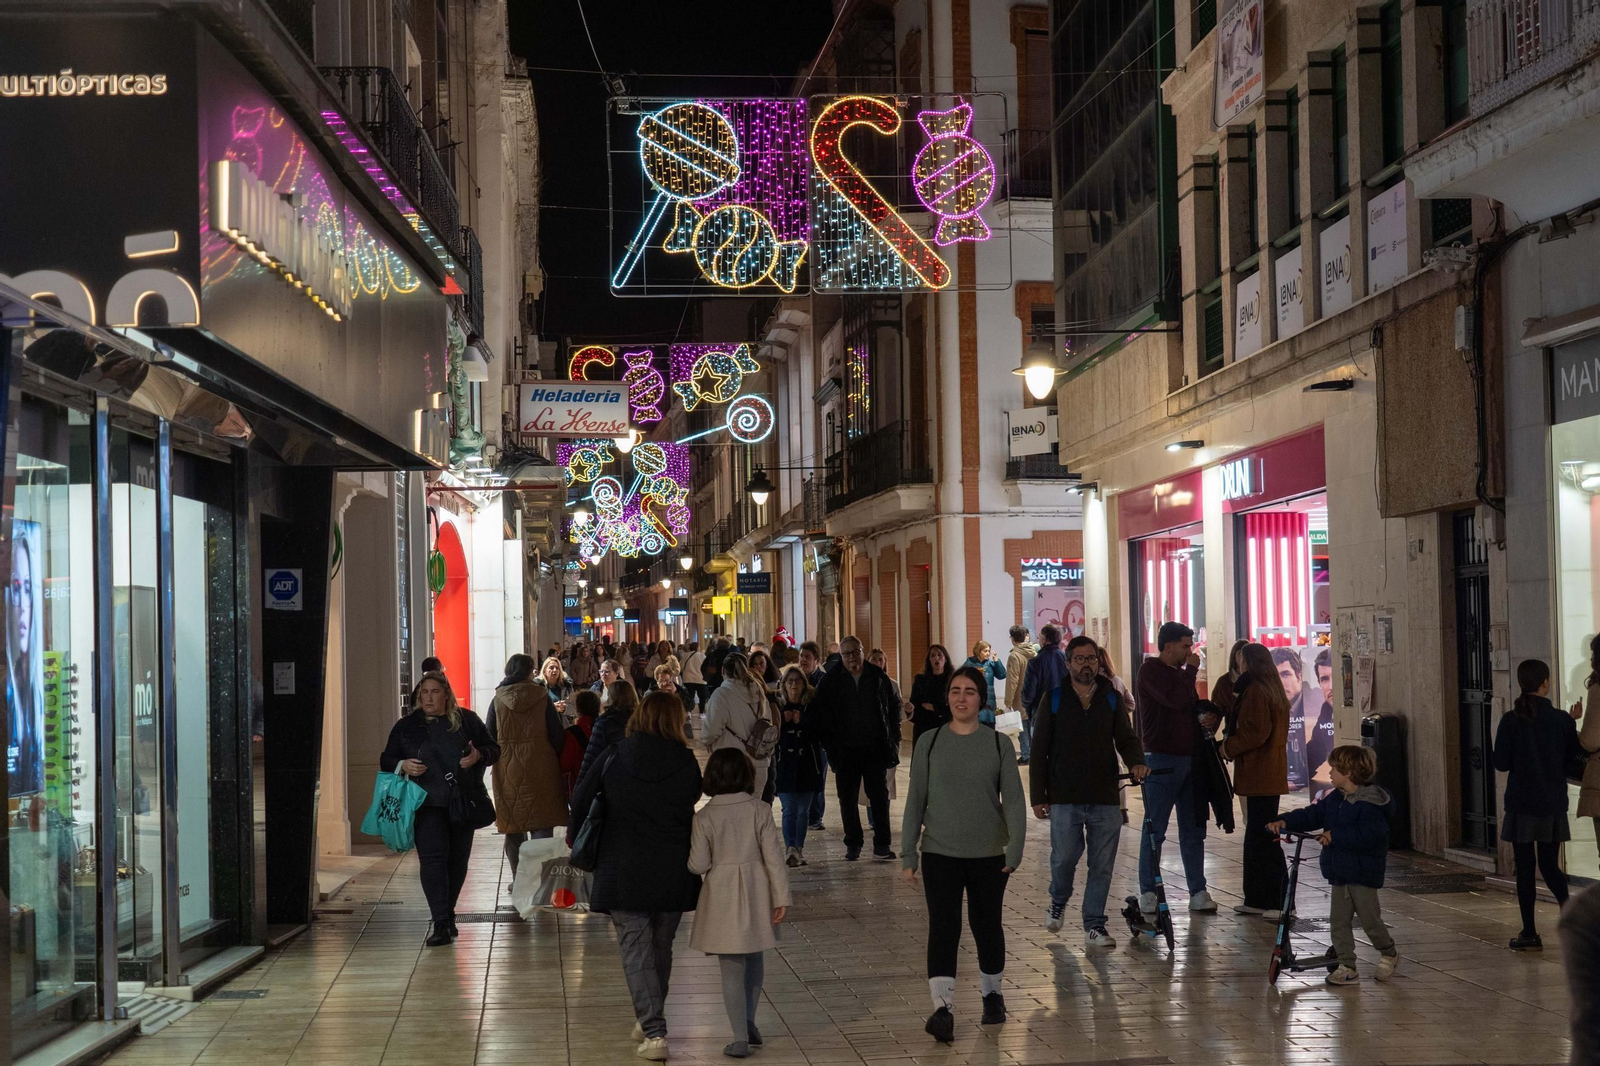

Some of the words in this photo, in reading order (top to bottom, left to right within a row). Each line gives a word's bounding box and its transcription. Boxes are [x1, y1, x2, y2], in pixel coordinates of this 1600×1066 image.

[523, 407, 556, 431] La
[1029, 565, 1085, 583] cajasur
[273, 581, 294, 591] ADT
